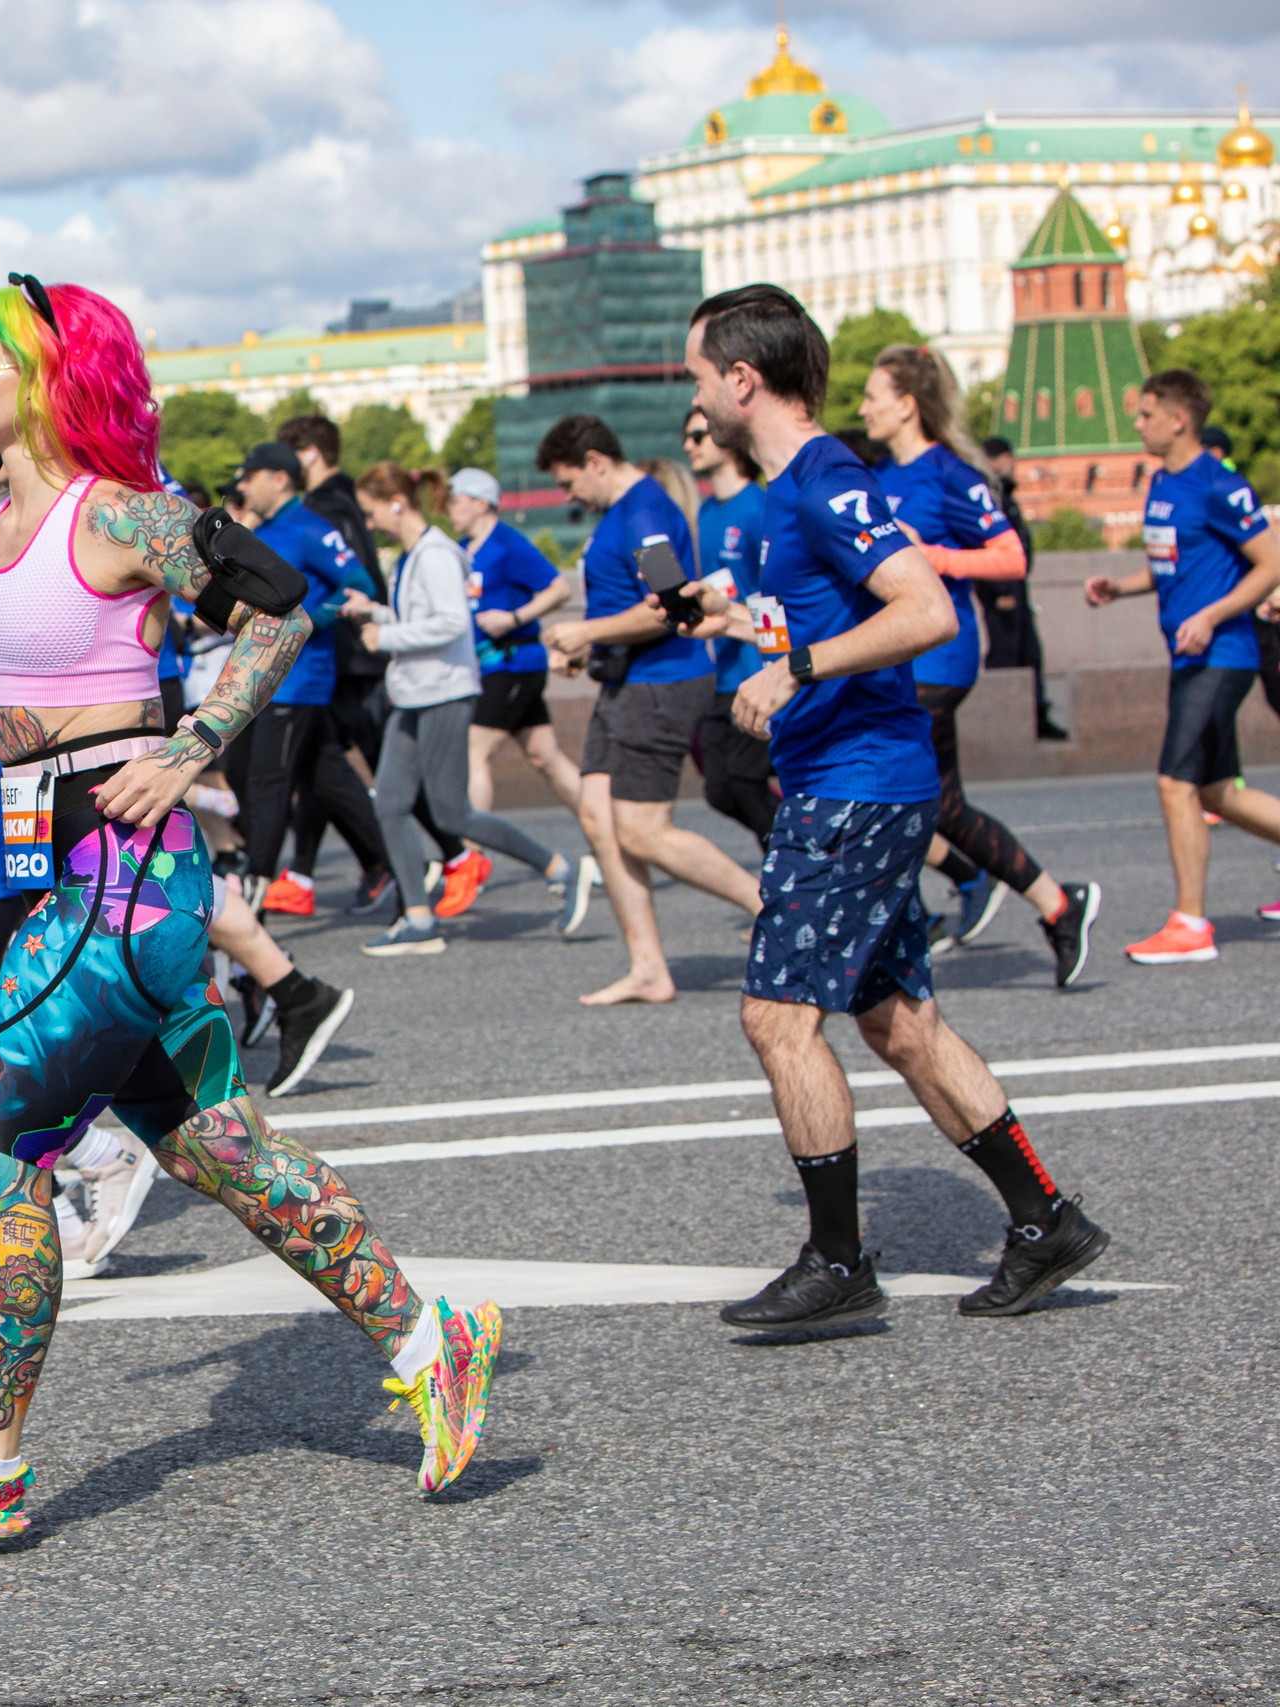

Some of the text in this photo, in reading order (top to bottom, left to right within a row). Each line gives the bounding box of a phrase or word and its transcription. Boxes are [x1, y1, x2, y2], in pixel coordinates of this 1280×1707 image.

[828, 489, 873, 524] 7
[967, 483, 994, 512] 7
[1228, 487, 1254, 513] 7
[4, 852, 49, 878] 020
